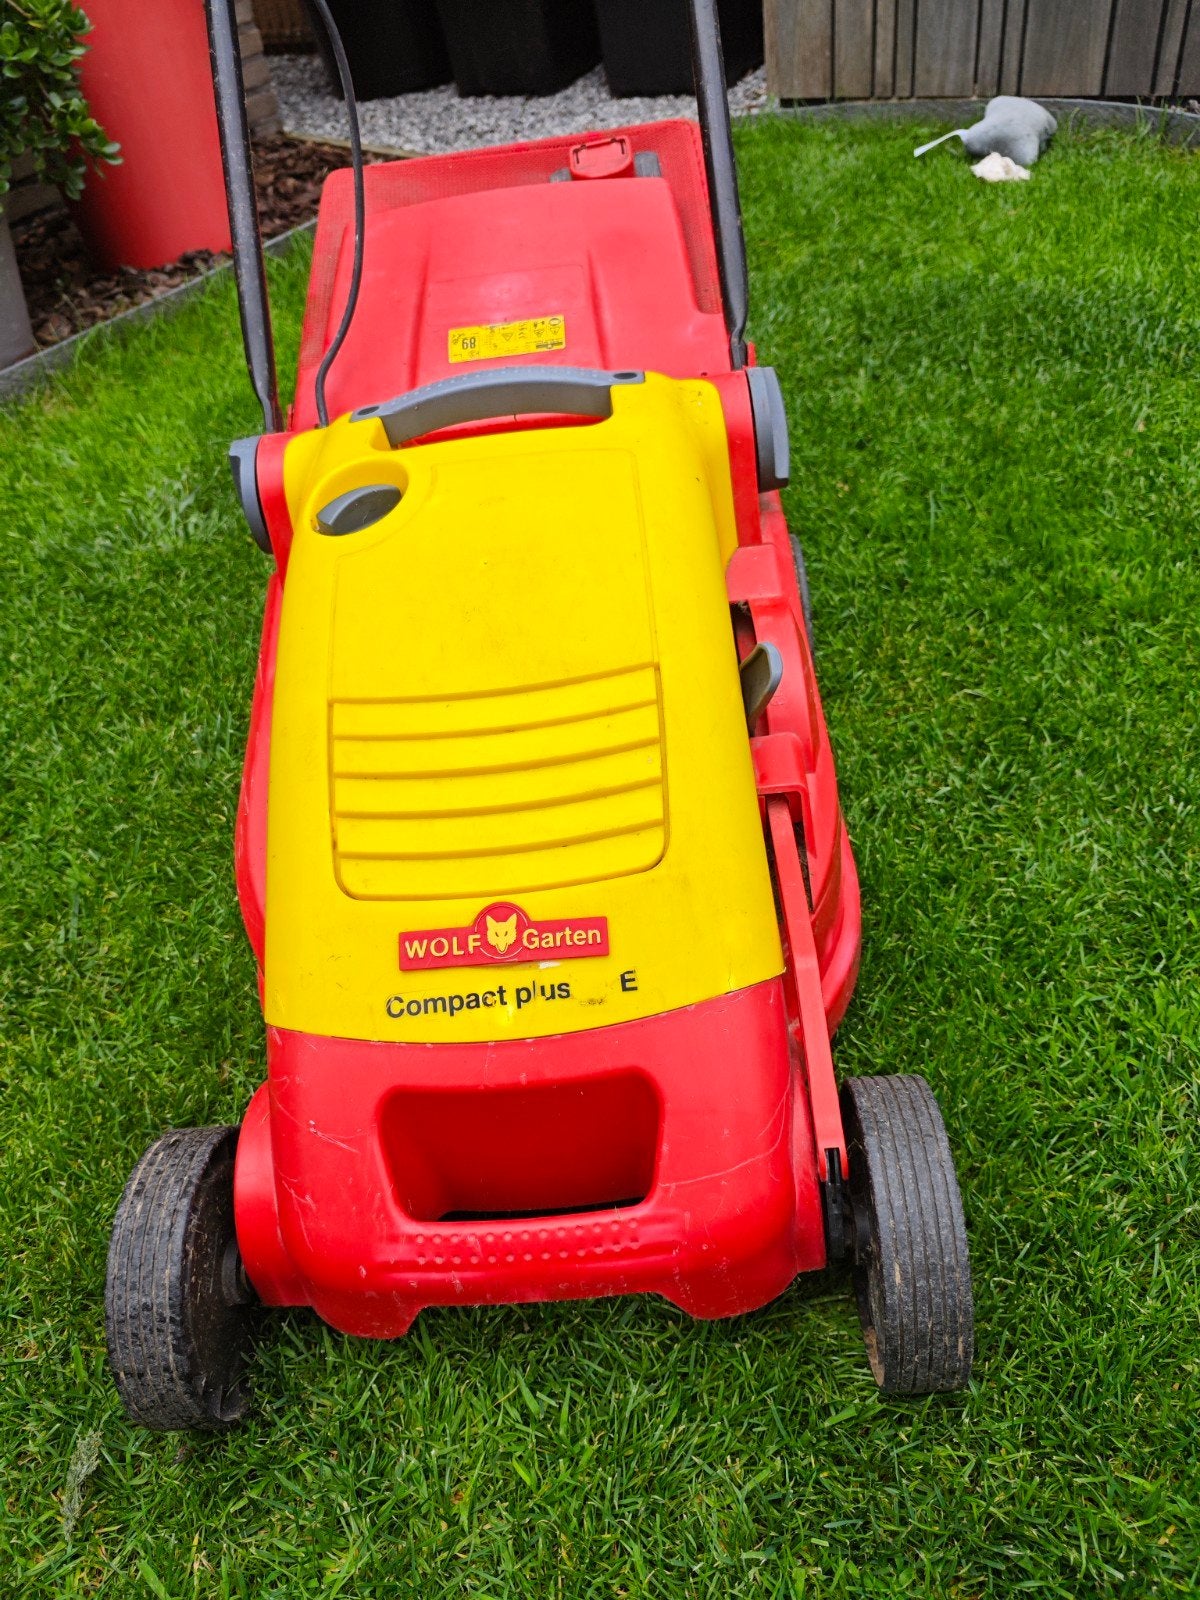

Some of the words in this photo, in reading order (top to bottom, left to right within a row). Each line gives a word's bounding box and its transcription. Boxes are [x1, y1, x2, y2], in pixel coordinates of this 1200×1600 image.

[405, 934, 482, 959] WOLF
[522, 927, 601, 950] Garten
[386, 985, 507, 1019] Compact
[515, 980, 571, 1009] plus
[620, 969, 638, 992] E
